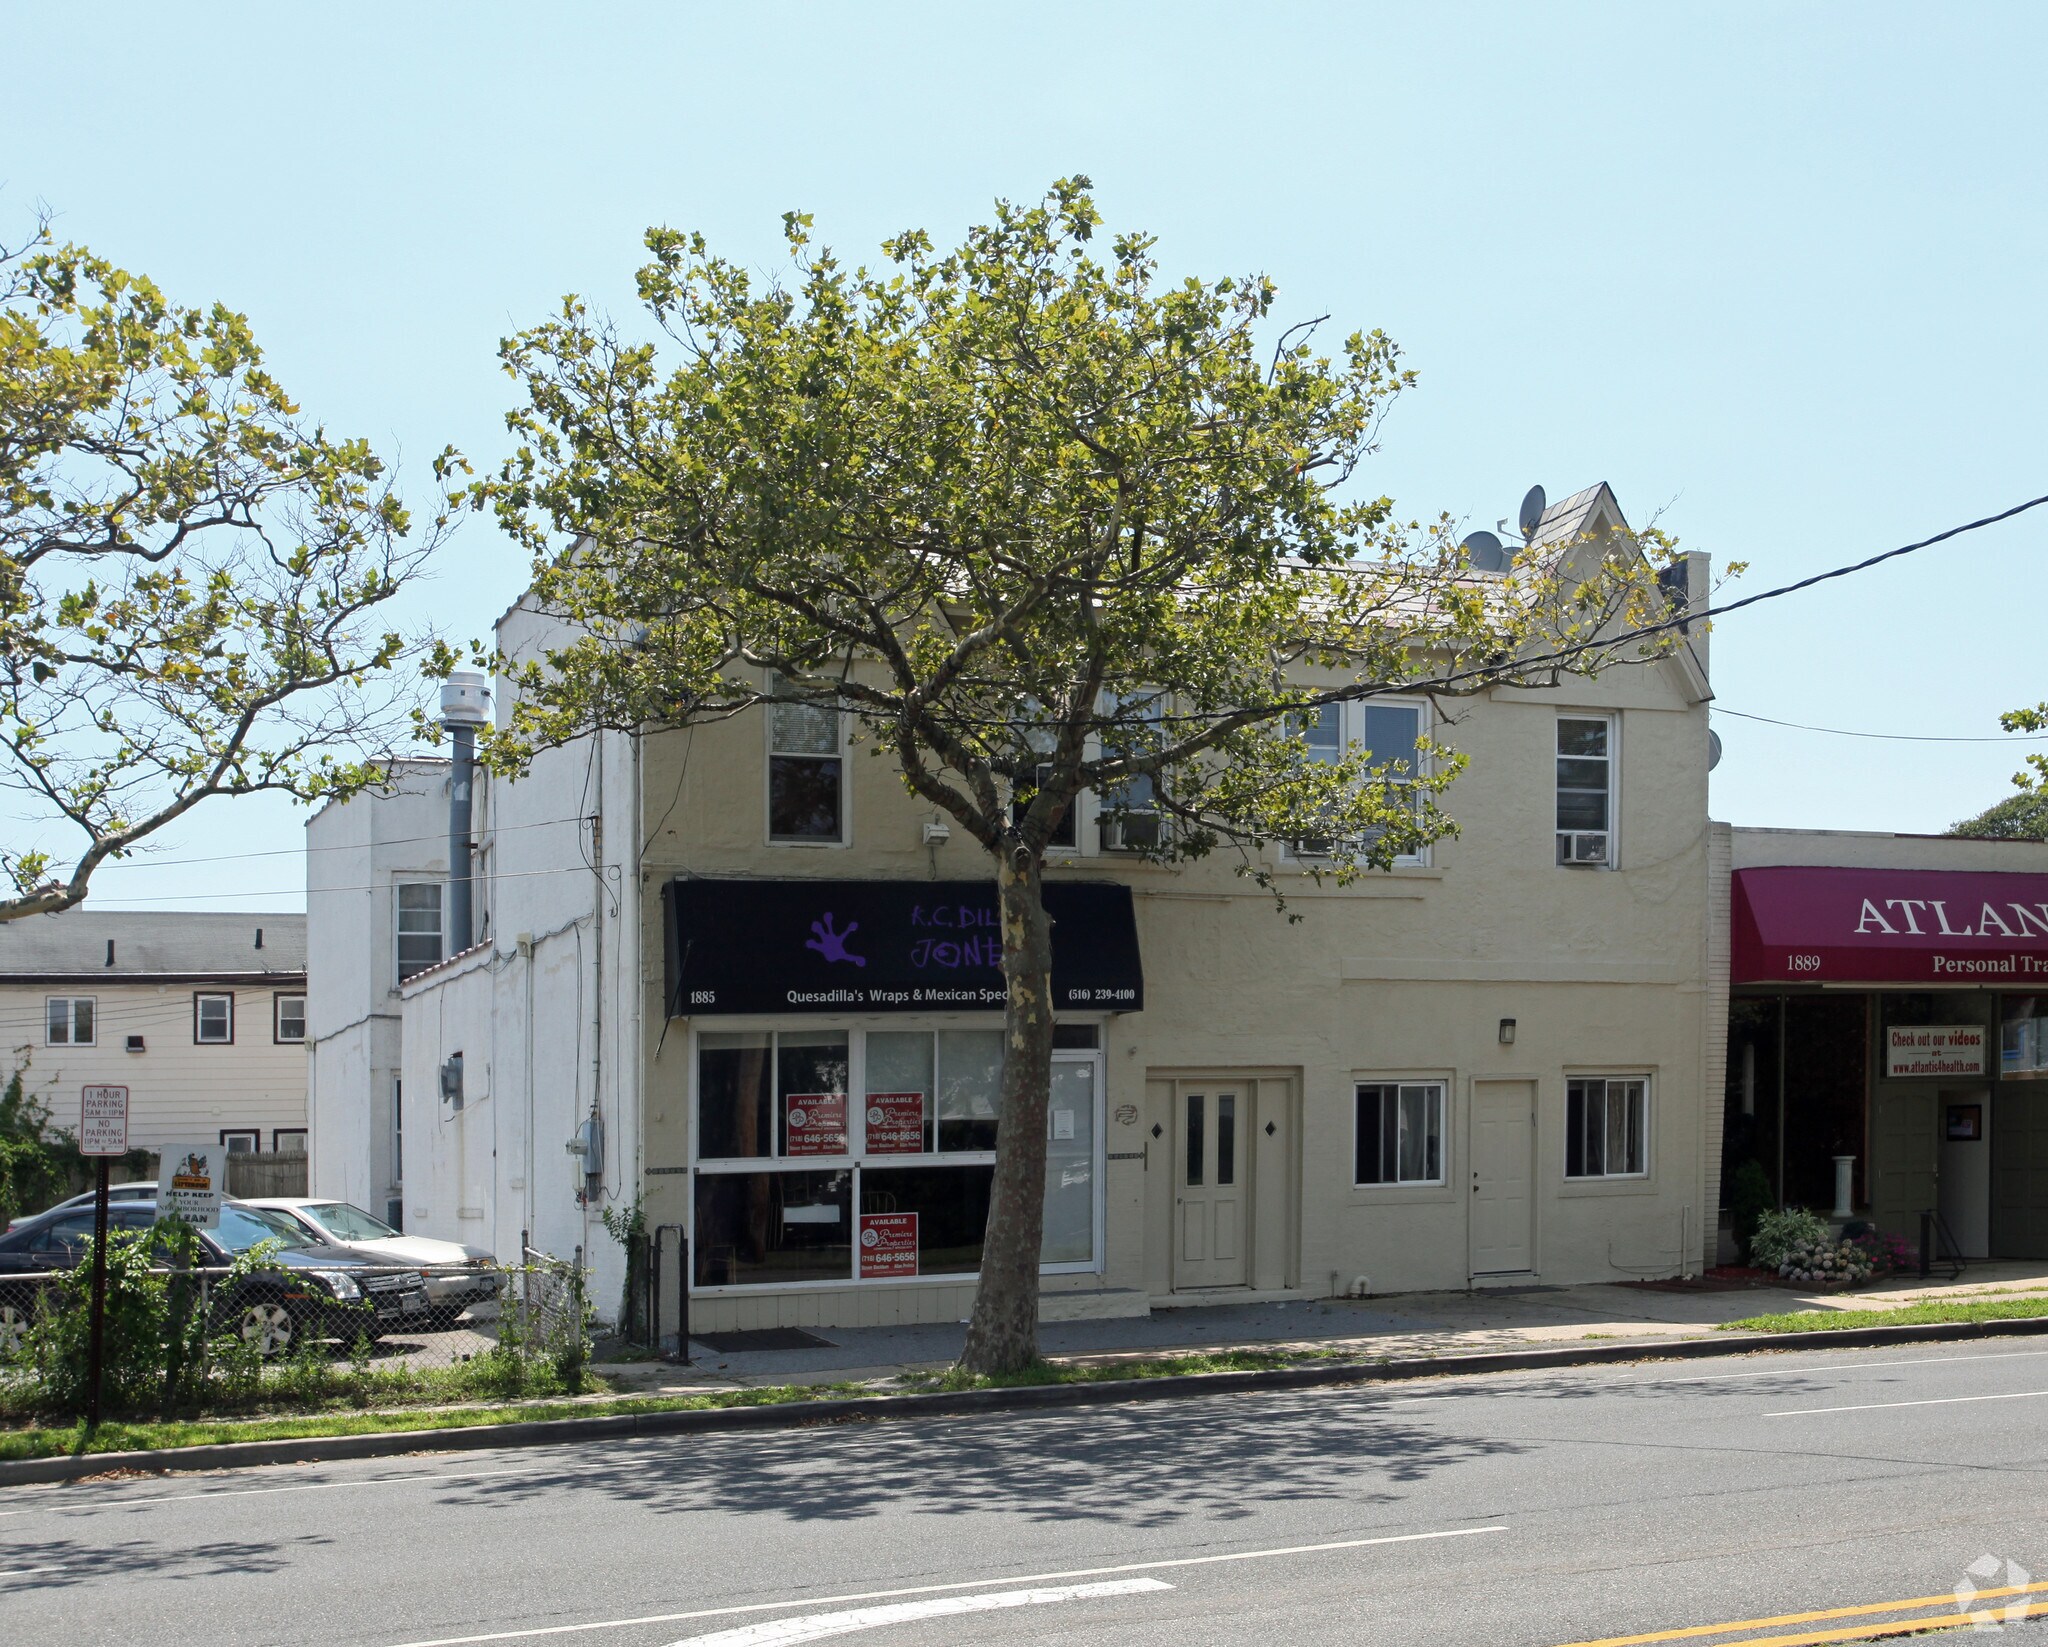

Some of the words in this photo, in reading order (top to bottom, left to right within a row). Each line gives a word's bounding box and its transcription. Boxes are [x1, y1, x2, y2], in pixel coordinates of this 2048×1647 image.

[958, 905, 1001, 928] DIL
[1853, 898, 2048, 937] ATLAN
[1787, 955, 1821, 971] 1889
[1933, 954, 2016, 972] Personal
[690, 991, 715, 1004] 1885
[787, 989, 864, 1004] Quesadilla's
[869, 989, 909, 1003] Wraps
[912, 988, 922, 1000] &
[925, 988, 976, 1000] Mexican
[1068, 989, 1090, 1000] (516)
[1095, 989, 1135, 1000] 239-4100
[1892, 1031, 1915, 1047] Check
[1917, 1032, 1930, 1046] out
[1932, 1035, 1945, 1046] our
[1948, 1030, 1981, 1046] videos
[1893, 1059, 1980, 1074] www.atlantis4health.com
[97, 1091, 120, 1099] HOUR
[86, 1100, 123, 1108] PARKING
[98, 1120, 110, 1128] NO
[85, 1129, 122, 1137] PARKING
[804, 1133, 845, 1143] 646-5656
[881, 1131, 920, 1141] 646-5656
[875, 1252, 915, 1262] 646-5656
